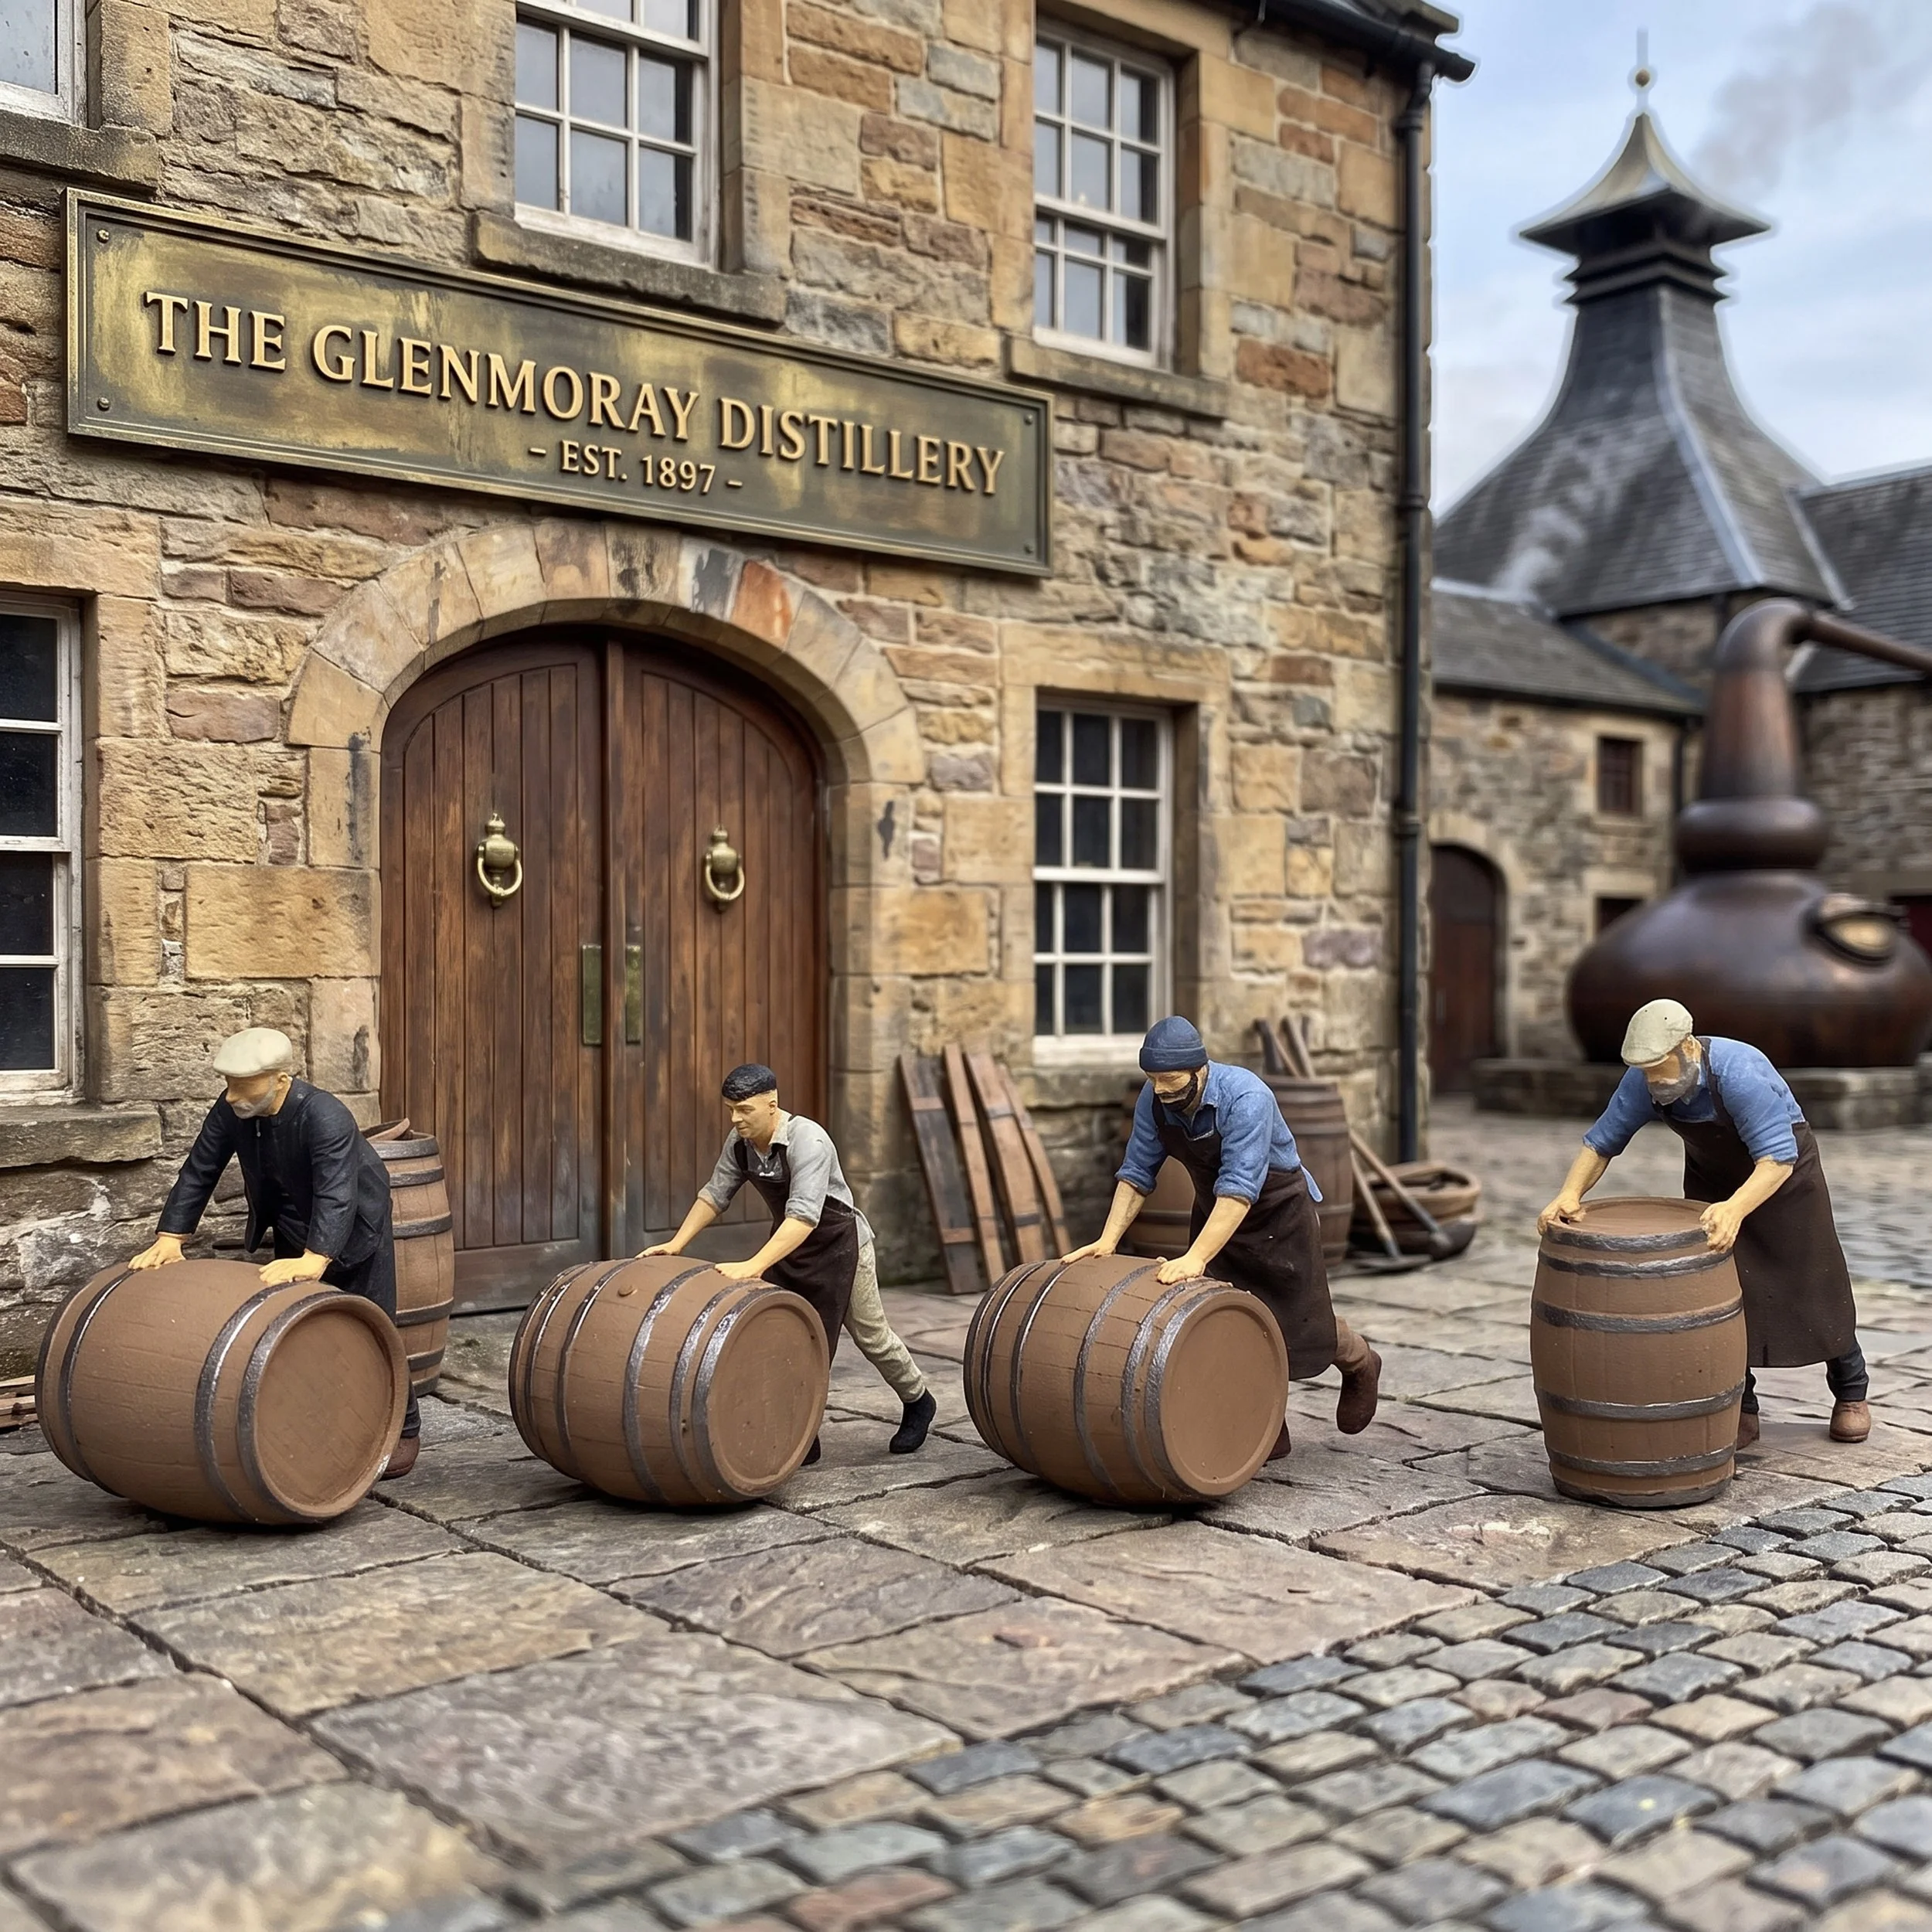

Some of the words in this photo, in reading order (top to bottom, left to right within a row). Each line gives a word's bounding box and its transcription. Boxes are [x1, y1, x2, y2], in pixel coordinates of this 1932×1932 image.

[145, 291, 287, 372] THE
[311, 324, 699, 442] GLENMORAY
[718, 397, 1005, 495] DISTILLERY
[560, 440, 628, 481] EST.
[641, 454, 716, 495] 1897
